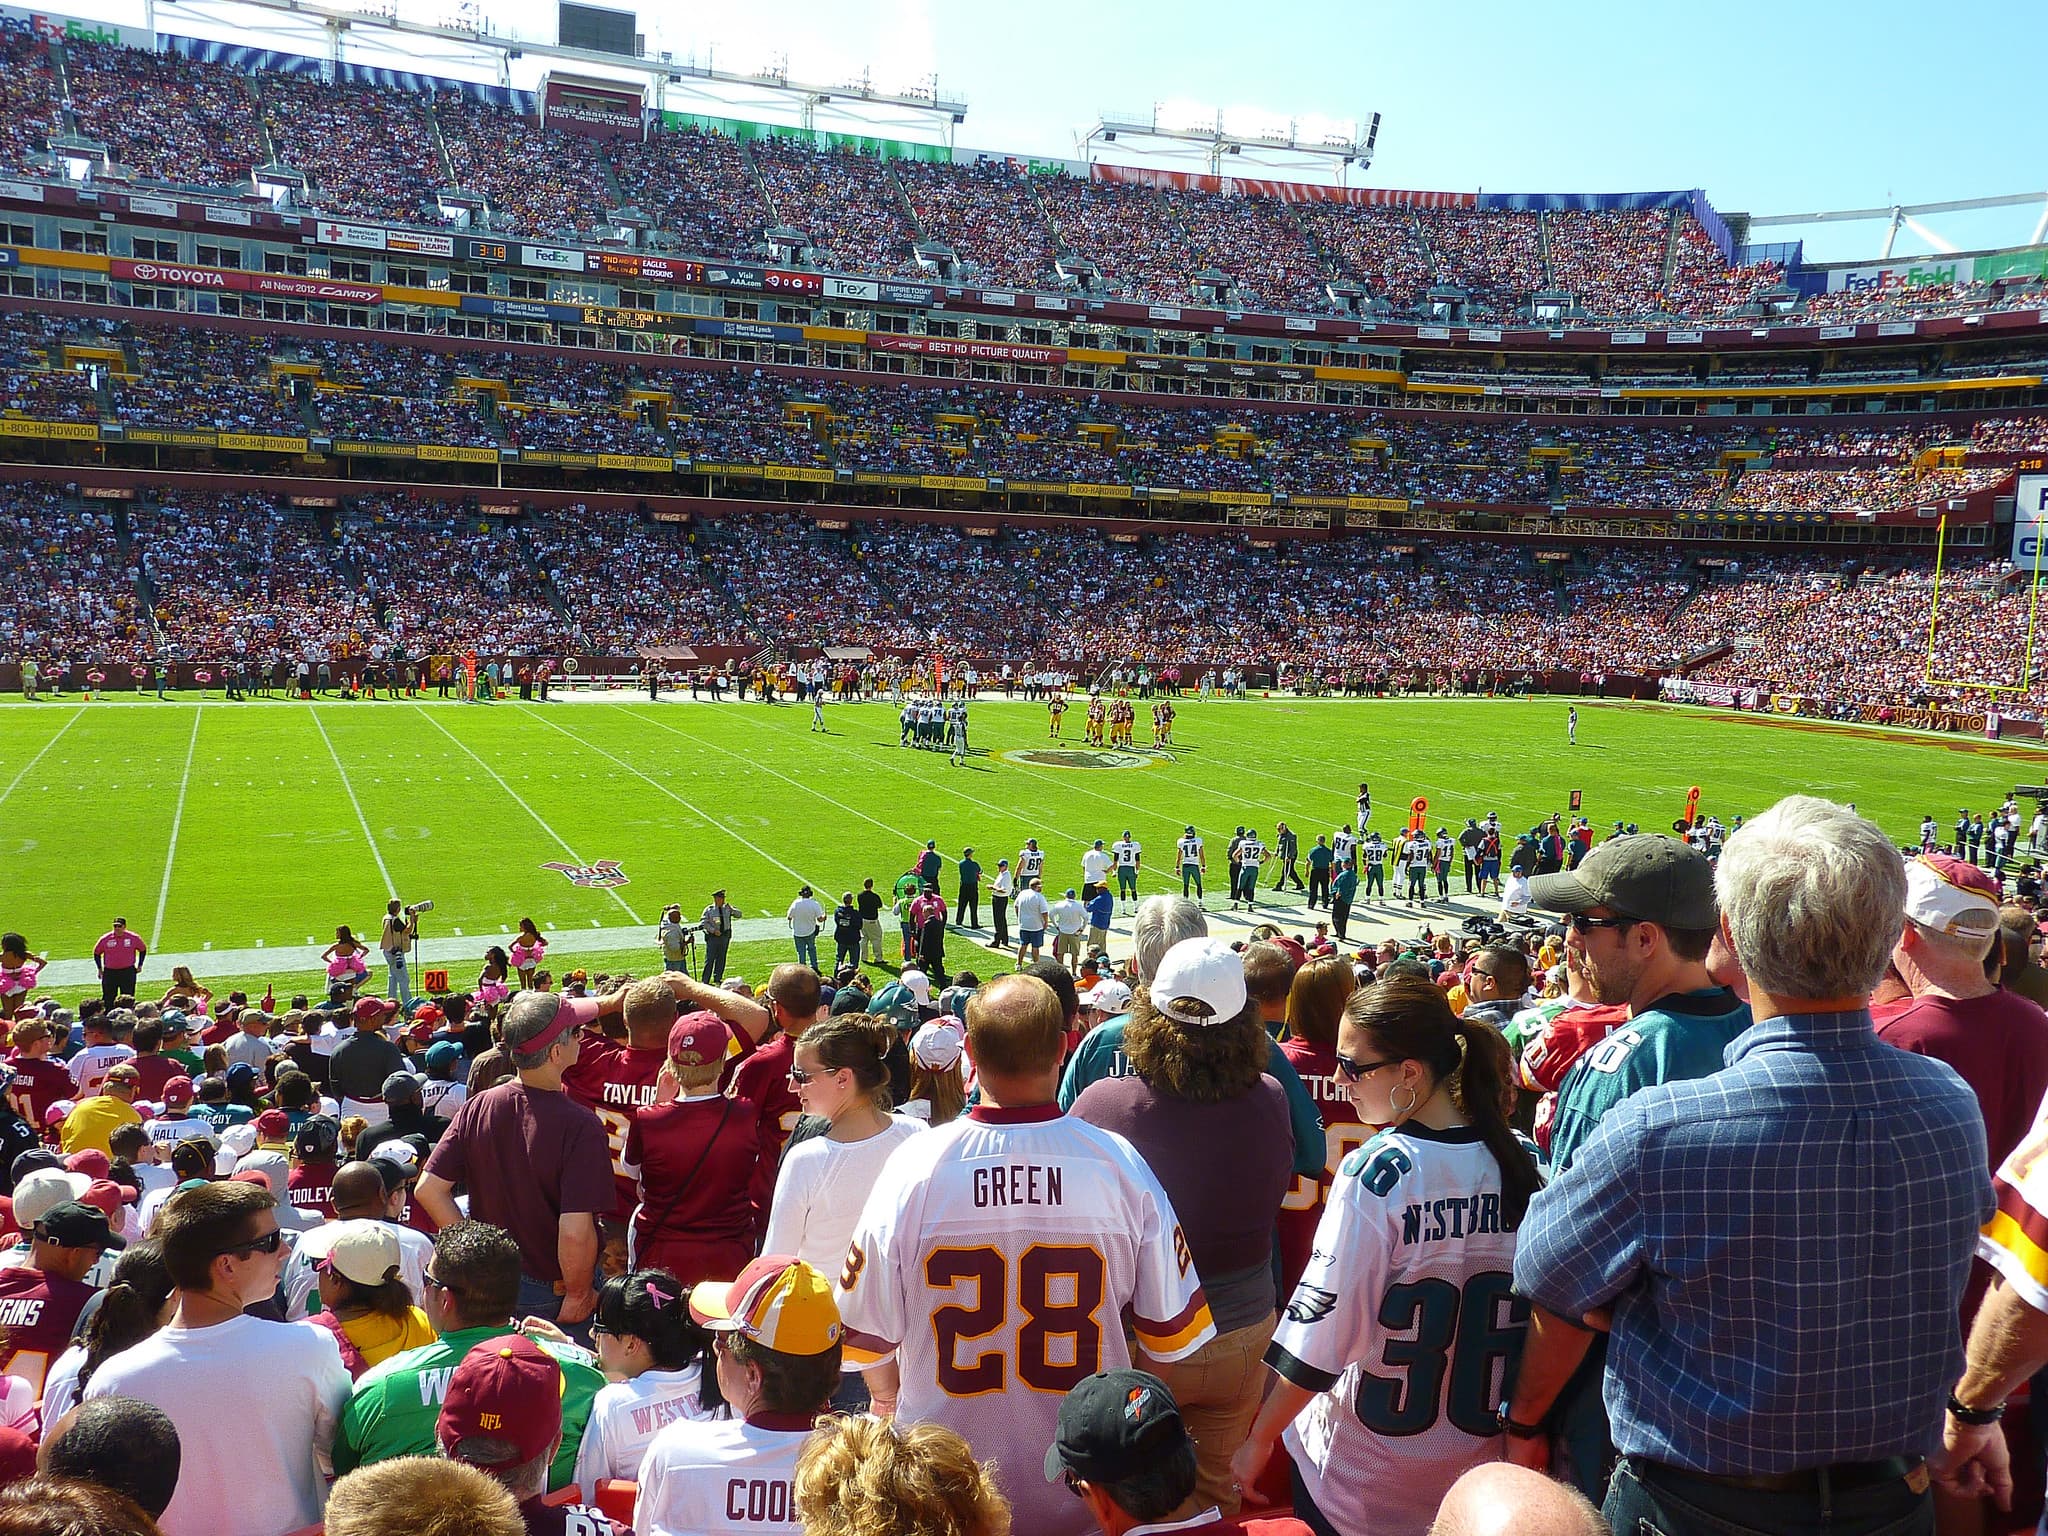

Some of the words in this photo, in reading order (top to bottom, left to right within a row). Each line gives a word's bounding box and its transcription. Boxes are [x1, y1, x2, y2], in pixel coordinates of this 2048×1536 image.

[549, 105, 576, 114] NEED
[579, 110, 640, 123] ASSISTANCE
[549, 111, 569, 119] TEXT
[348, 228, 378, 237] American
[404, 233, 426, 241] Future
[421, 242, 450, 251] LEARN
[479, 245, 505, 258] 3:18
[536, 249, 569, 262] FedEx
[602, 255, 618, 264] 2ND
[642, 260, 667, 269] EAGLES
[160, 268, 224, 285] TOYOTA
[629, 267, 639, 276] 49
[642, 269, 674, 279] REDSKINS
[738, 271, 754, 279] Visit
[730, 278, 762, 288] AAA.com
[834, 280, 868, 296] Trex
[260, 280, 273, 290] All
[274, 281, 294, 292] New
[295, 283, 316, 294] 2012
[318, 286, 380, 301] CAMRY
[886, 286, 910, 294] EMPIRE
[911, 287, 933, 296] TODAY
[507, 302, 526, 311] Merrill
[527, 304, 546, 313] Lynch
[584, 308, 593, 316] OF
[616, 311, 631, 320] 2ND
[634, 313, 654, 323] DOWN
[584, 316, 604, 325] BALL
[608, 318, 645, 329] MIDFIELD
[736, 324, 755, 332] Merrill
[898, 341, 922, 349] verizon
[929, 342, 951, 352] BEST
[955, 344, 967, 354] HD
[971, 345, 1008, 358] PICTURE
[1012, 348, 1050, 360] QUALITY
[0, 421, 95, 438] 1-800-HARDWOOD
[129, 431, 161, 441] LUMBER
[164, 434, 216, 445] LIQUIDATORS
[220, 435, 305, 451] 1-800-HARDWOOD
[337, 444, 367, 452] LUMBER
[369, 445, 416, 455] LIQUIDATORS
[419, 446, 495, 461] 1-800-HARDWOOD
[525, 452, 552, 460] LUMBER
[600, 456, 670, 469] 1-800-HARDWOOD
[2019, 460, 2043, 469] 3:18
[767, 467, 832, 481] 1-800-HARDWOOD
[923, 476, 985, 489] 1-800-HARDWOOD
[1070, 485, 1129, 497] 1-800-HARDWOOD
[1211, 493, 1269, 503] 1-800-HARDWOOD
[1123, 849, 1131, 863] 3
[1182, 844, 1198, 859] 14
[1244, 846, 1259, 860] 32
[1366, 848, 1384, 862] 28
[427, 972, 447, 991] 20
[153, 1129, 180, 1141] HALL
[973, 1164, 1063, 1208] GREEN
[0, 1298, 44, 1327] GINS
[923, 1241, 1107, 1397] 28
[1354, 1270, 1533, 1438] 36
[630, 1391, 705, 1435] WESTB
[480, 1412, 502, 1431] NFL
